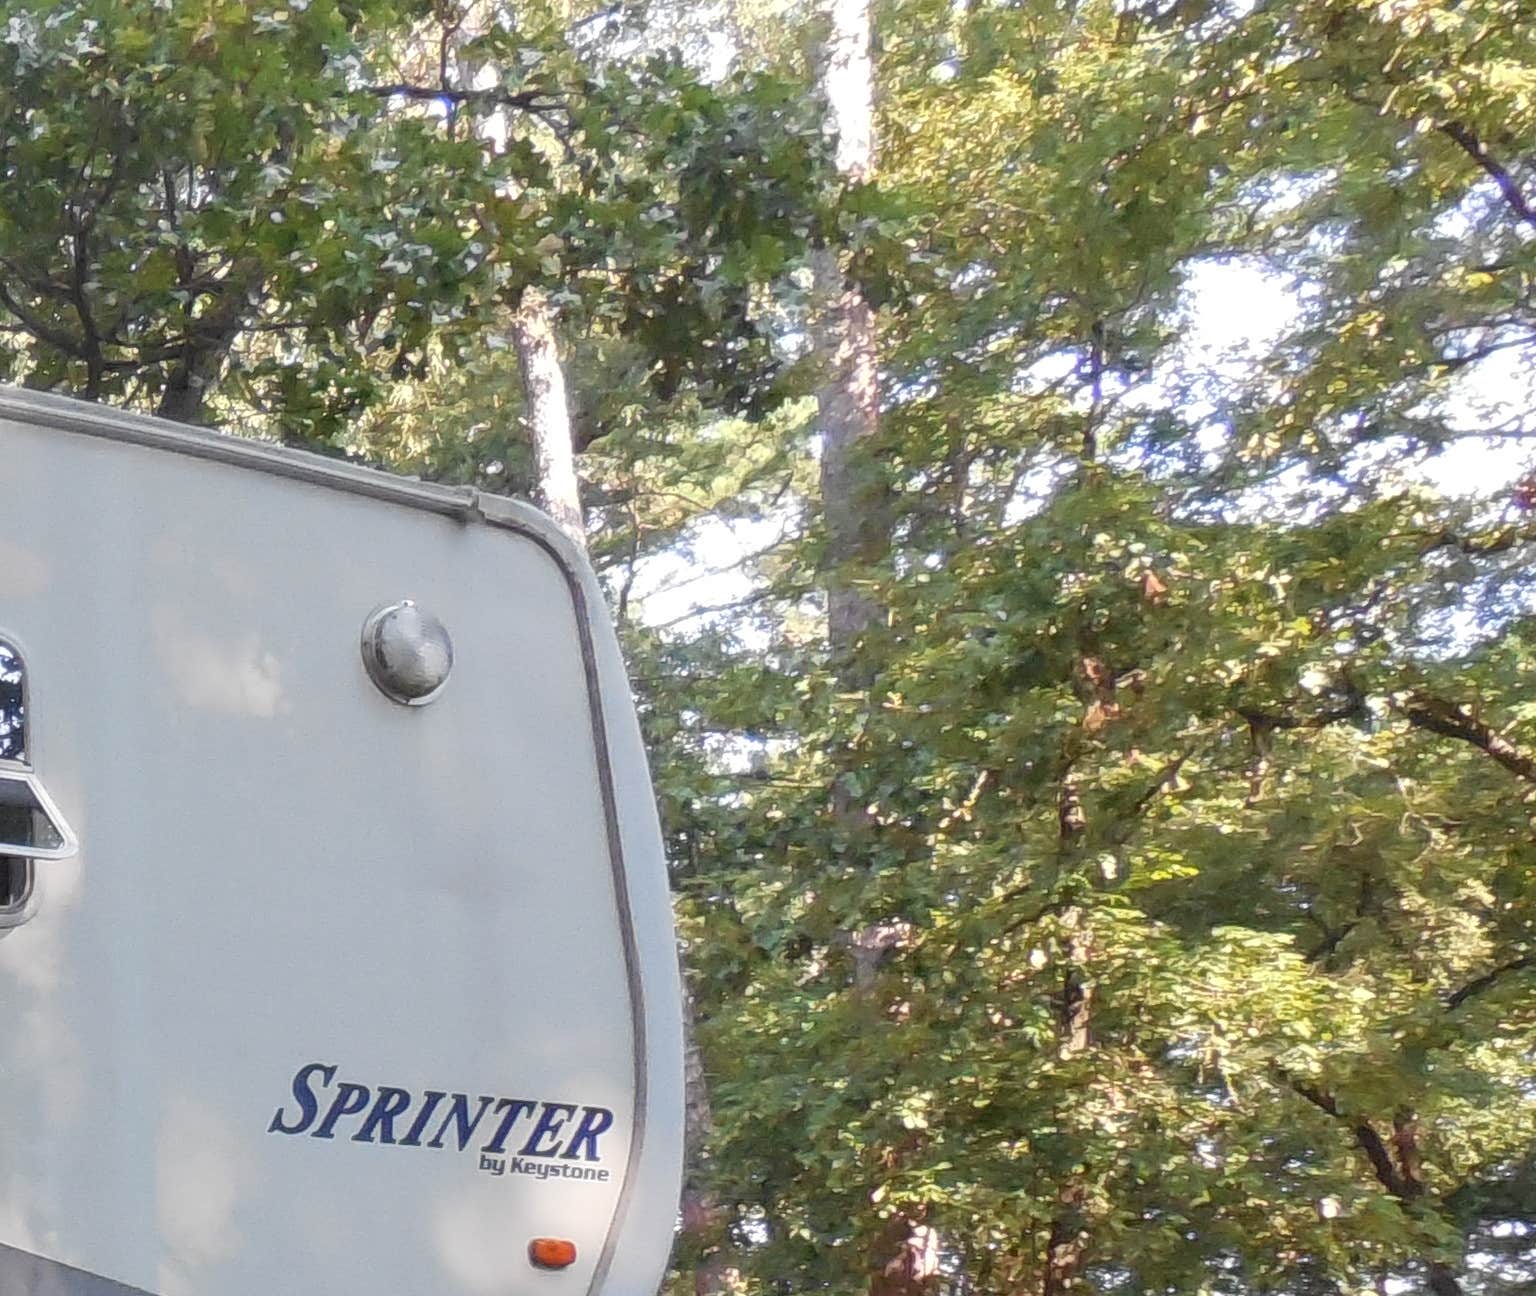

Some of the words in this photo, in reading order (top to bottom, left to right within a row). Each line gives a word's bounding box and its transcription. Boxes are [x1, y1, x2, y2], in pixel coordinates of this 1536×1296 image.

[268, 1063, 614, 1161] SPRINTER
[479, 1154, 506, 1176] by
[510, 1157, 610, 1182] Keystone
